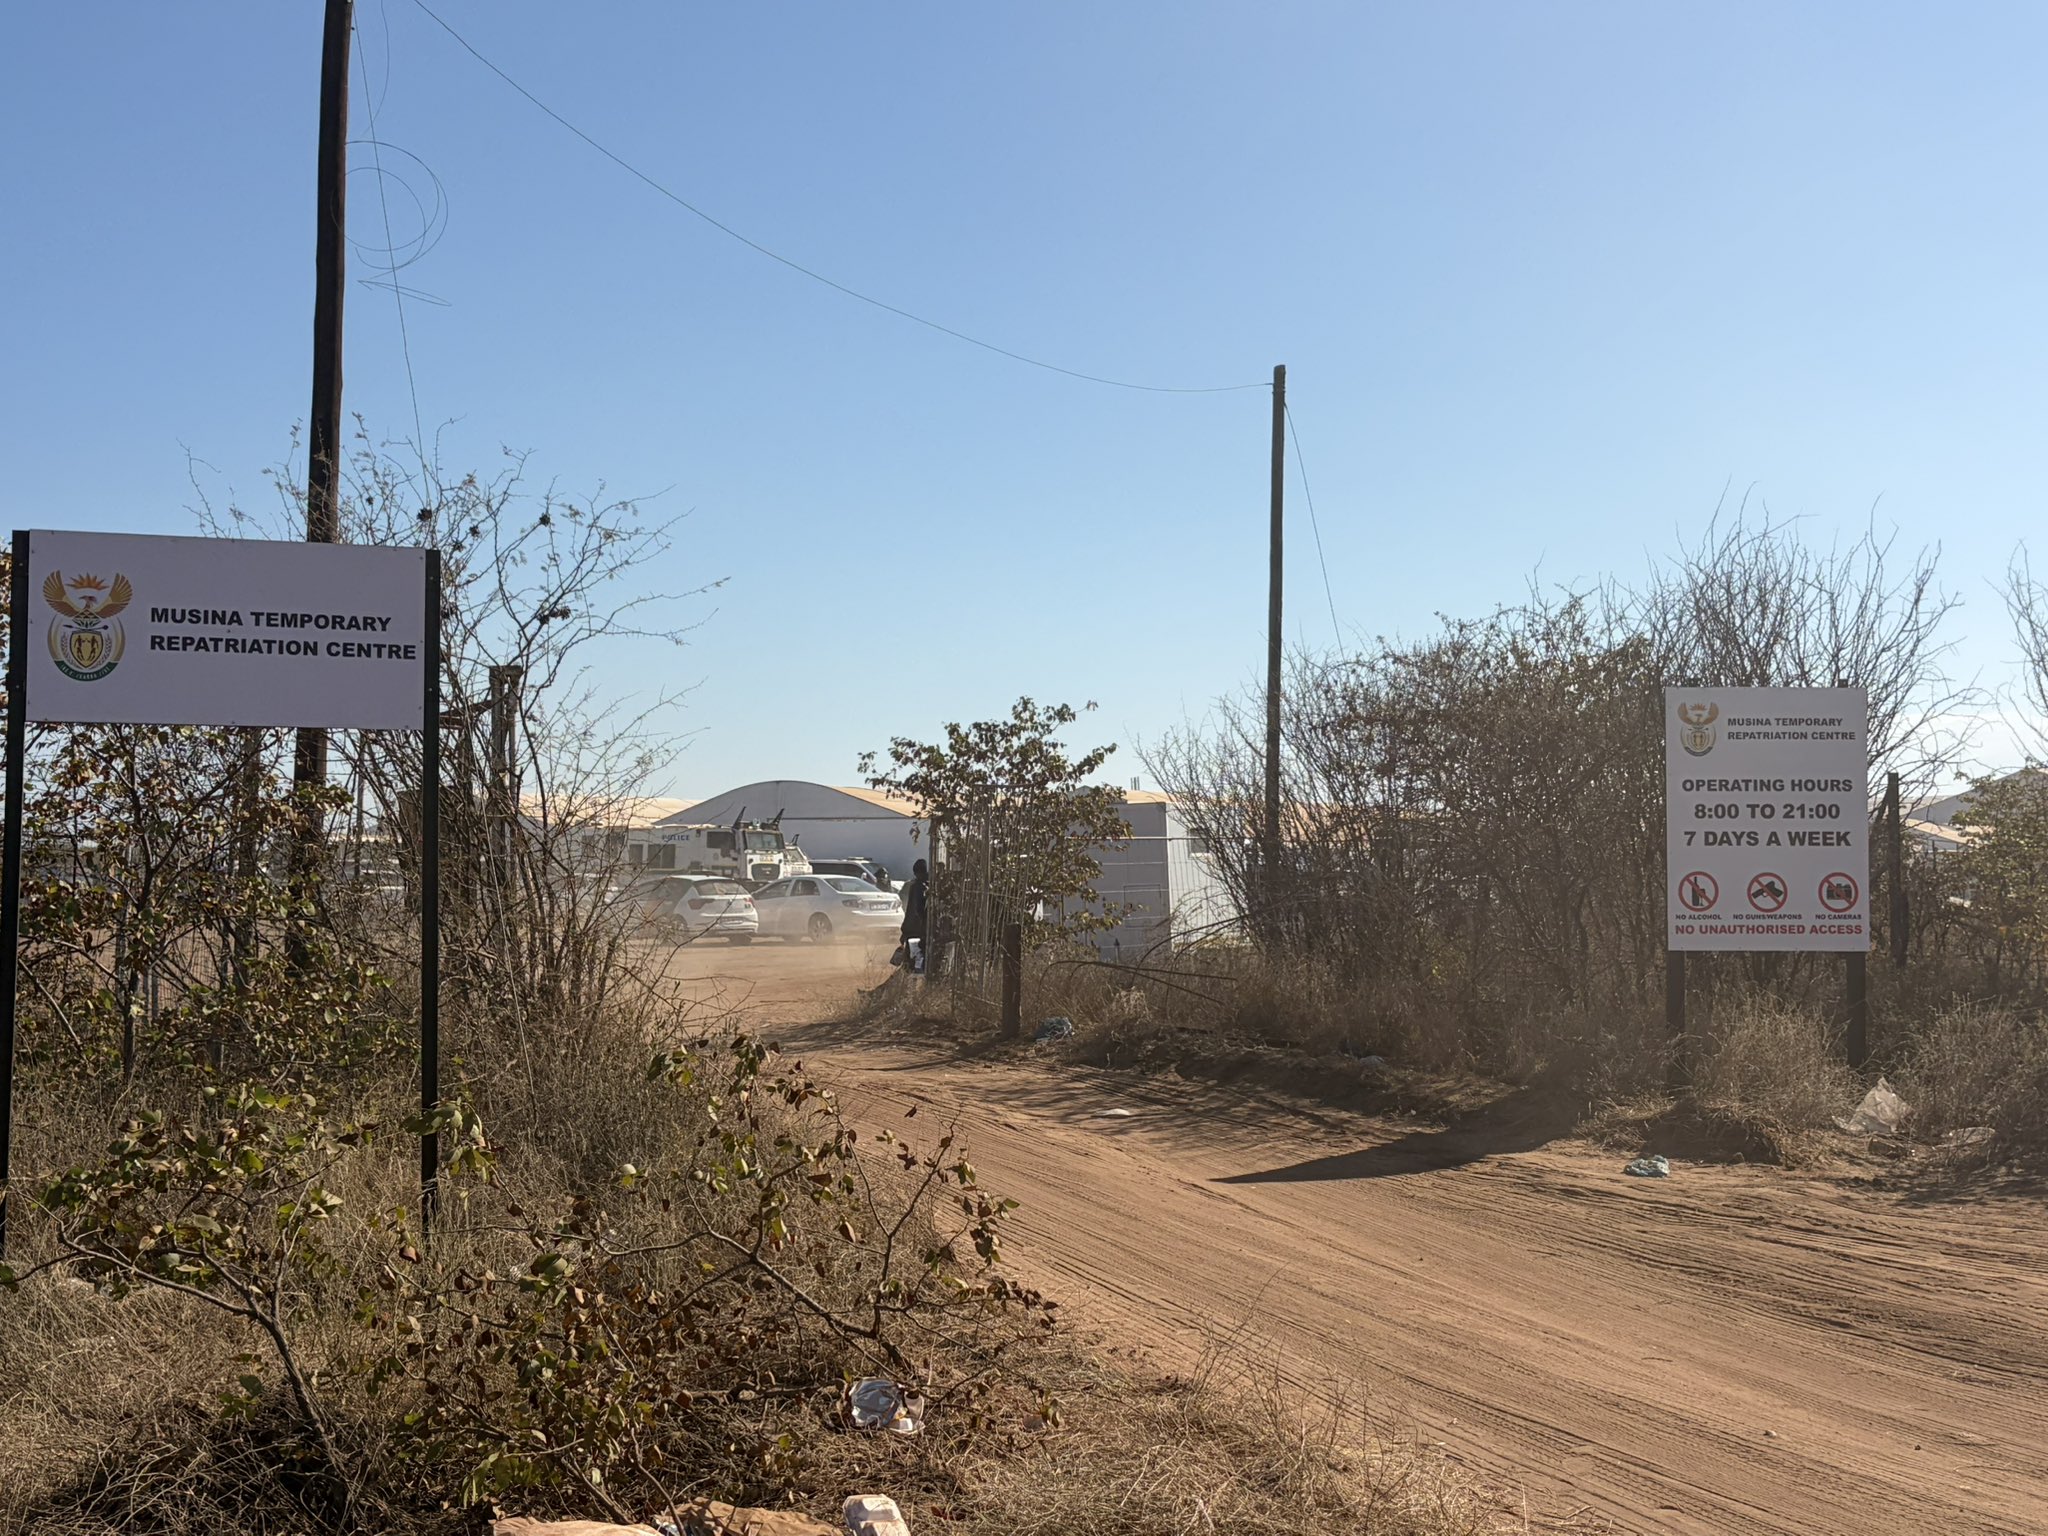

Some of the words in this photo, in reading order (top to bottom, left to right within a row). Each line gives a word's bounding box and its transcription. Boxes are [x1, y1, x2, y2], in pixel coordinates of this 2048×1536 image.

[151, 607, 243, 626] MUSINA
[250, 611, 392, 632] TEMPORARY
[150, 635, 318, 656] REPATRIATION
[326, 642, 416, 660] CENTRE
[1727, 718, 1772, 727] MUSINA
[1775, 718, 1843, 727] TEMPORARY
[1727, 731, 1808, 740] REPATRIATION
[1811, 731, 1856, 740] CENTRE
[1682, 779, 1785, 792] OPERATING
[1791, 779, 1853, 792] HOURS
[1694, 803, 1740, 819] 8:00
[1746, 804, 1776, 819] TO
[1782, 803, 1841, 819] 21:00
[1684, 831, 1696, 846] 7
[1704, 831, 1759, 846] DAYS
[1766, 831, 1781, 846] A
[1787, 831, 1852, 846] WEEK
[1675, 925, 1695, 934] NO
[1699, 925, 1805, 934] UNAUTHORISED
[1810, 925, 1863, 934] ACCESS
